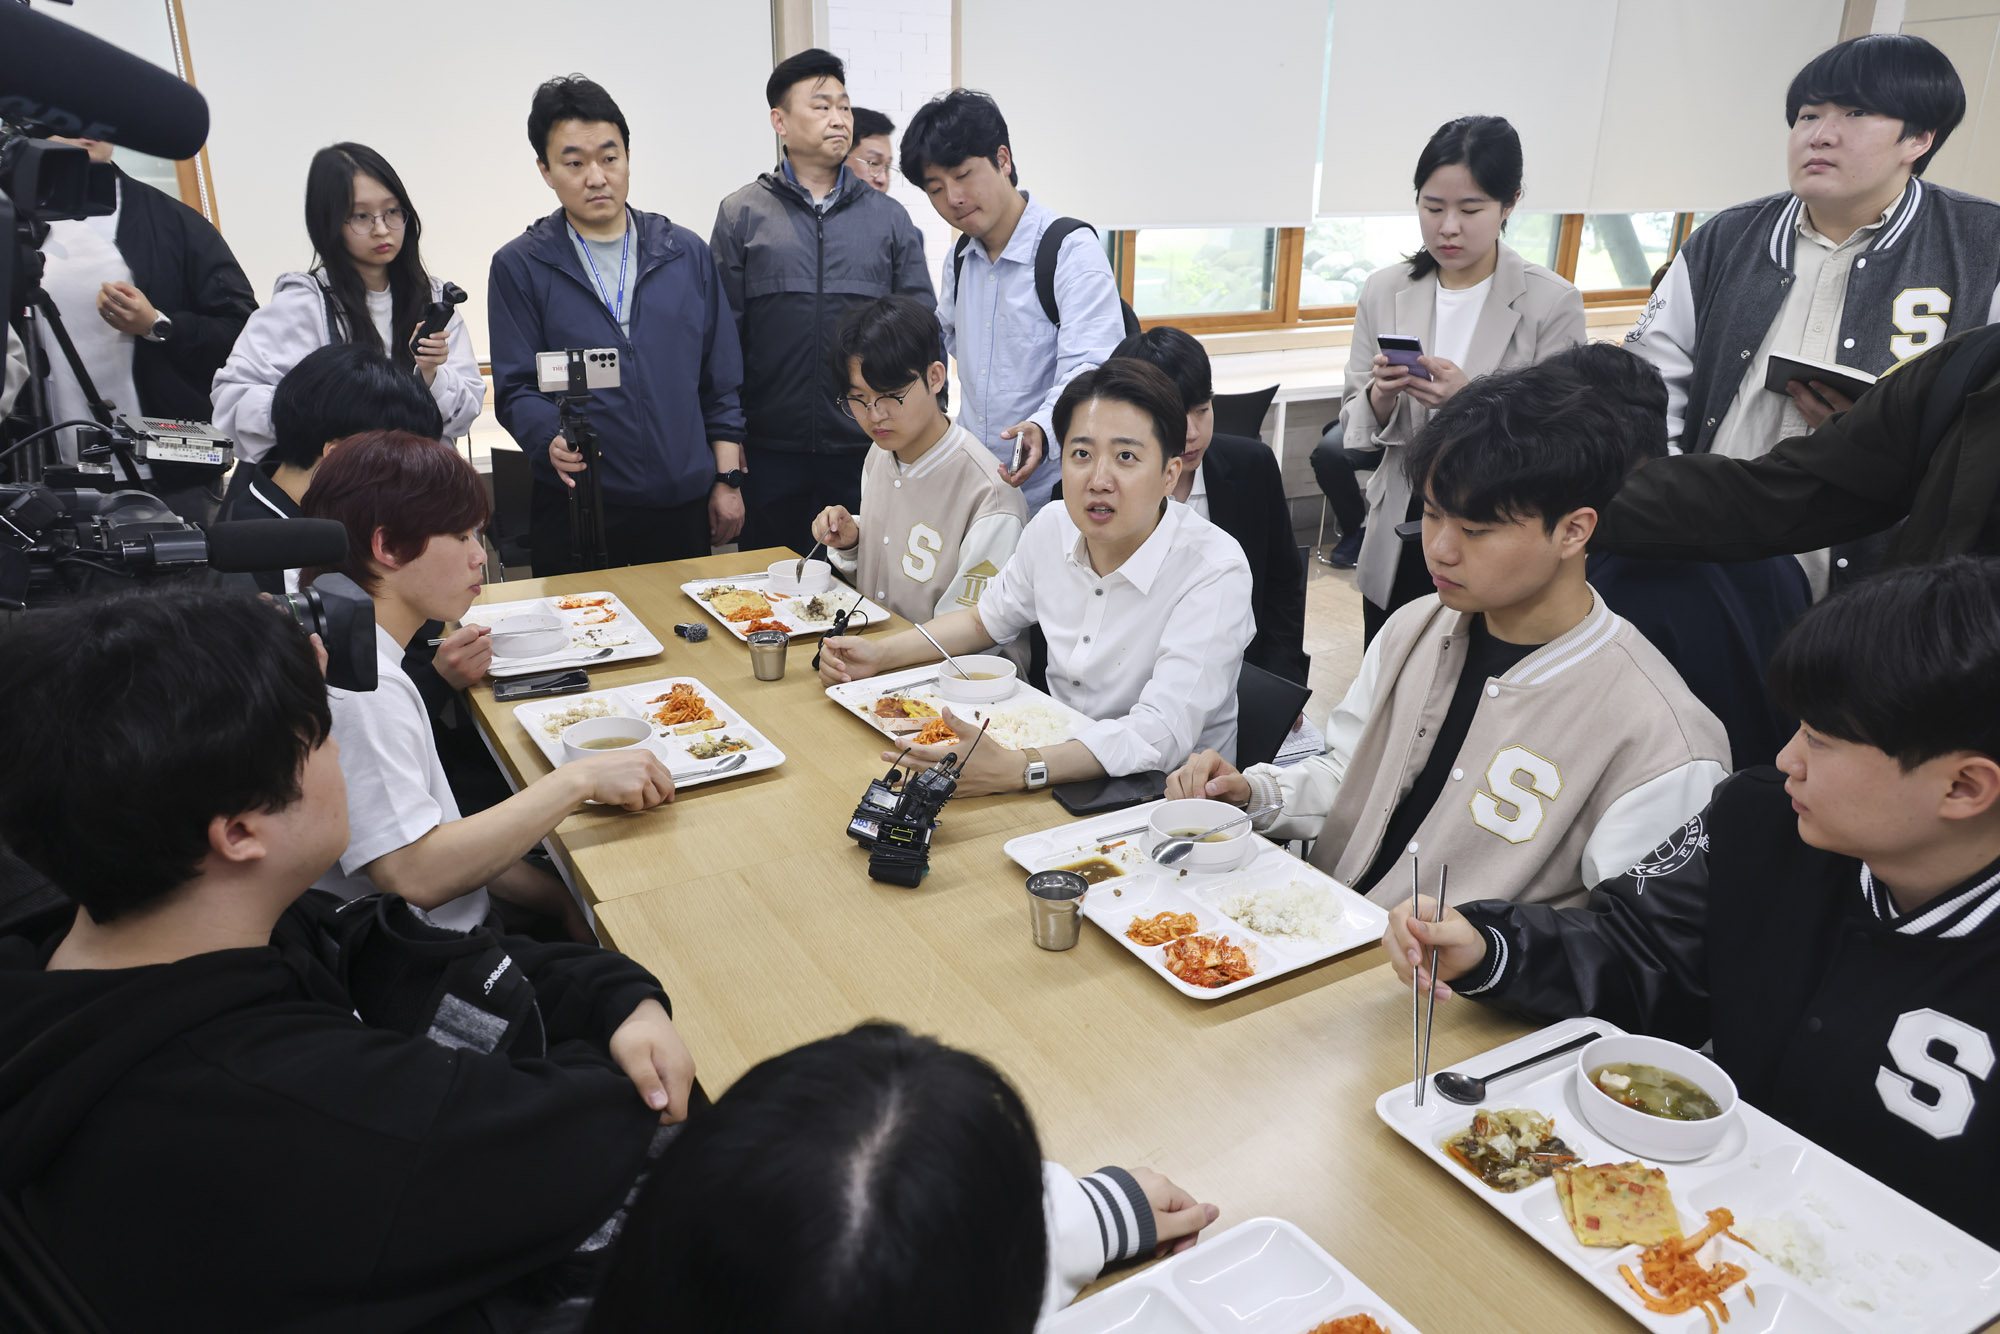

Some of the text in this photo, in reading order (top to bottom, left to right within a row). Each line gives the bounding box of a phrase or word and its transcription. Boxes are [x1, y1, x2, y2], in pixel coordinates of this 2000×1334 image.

[1890, 287, 1951, 361] S
[901, 522, 944, 584] S
[853, 817, 870, 829] SBS
[1469, 744, 1564, 845] S
[1875, 1007, 1996, 1140] S
